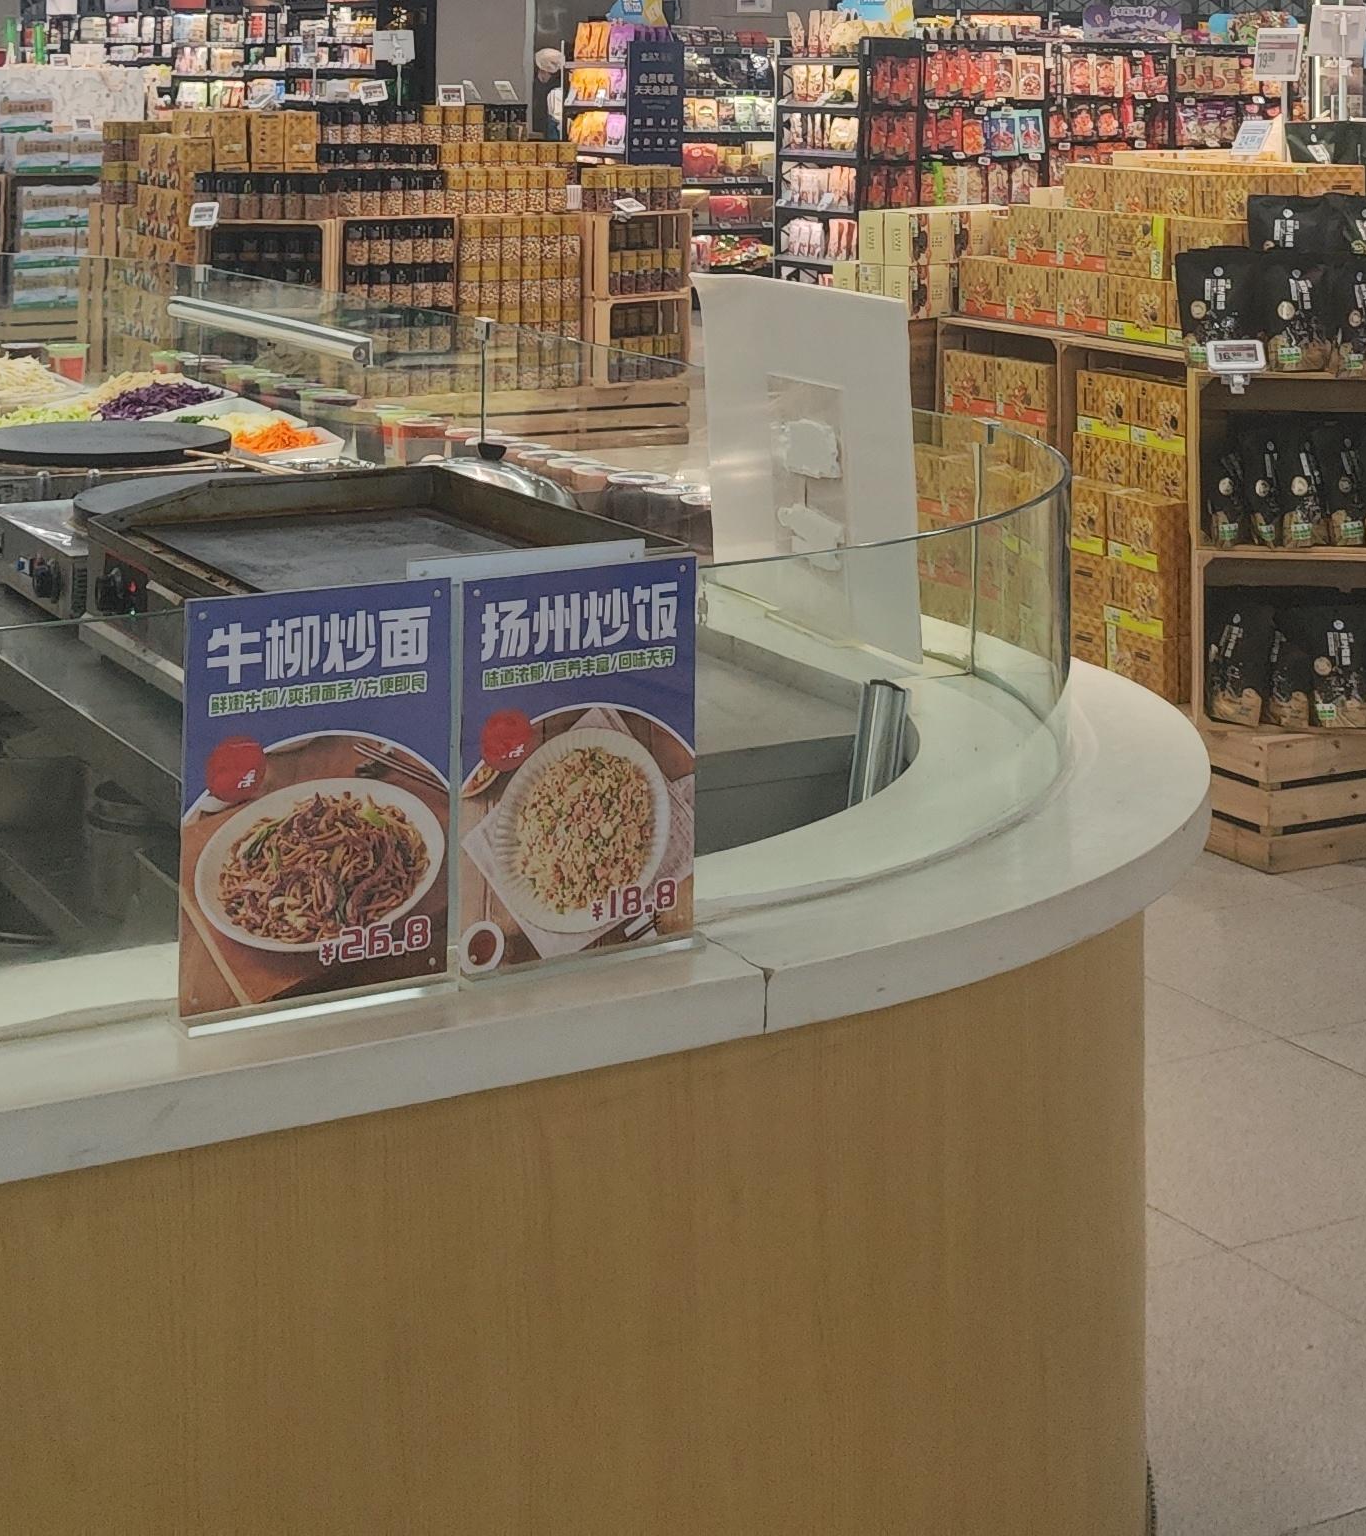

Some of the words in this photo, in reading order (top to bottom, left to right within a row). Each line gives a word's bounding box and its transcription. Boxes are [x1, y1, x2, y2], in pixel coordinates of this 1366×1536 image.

[206, 606, 432, 685] 牛柳炒面
[480, 581, 679, 662] 扬州炒饭
[590, 878, 678, 923] ¥18.8
[319, 915, 432, 965] ¥26.8
